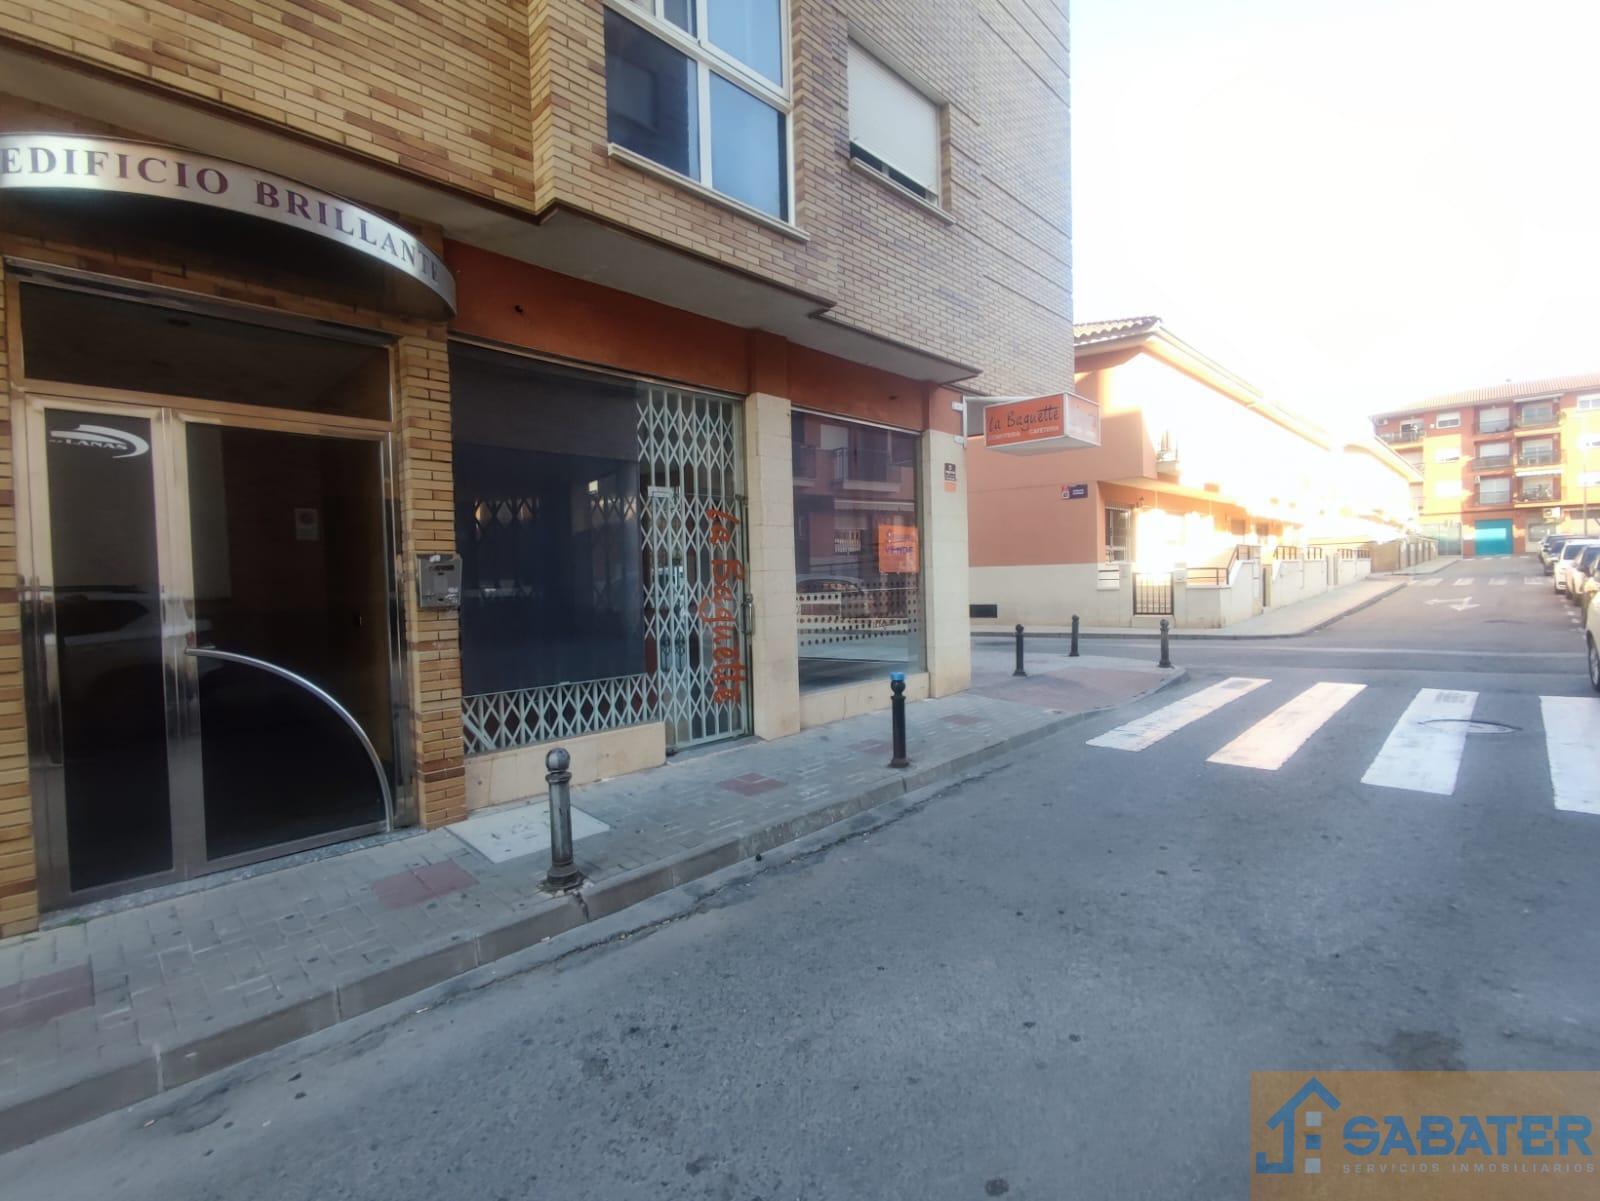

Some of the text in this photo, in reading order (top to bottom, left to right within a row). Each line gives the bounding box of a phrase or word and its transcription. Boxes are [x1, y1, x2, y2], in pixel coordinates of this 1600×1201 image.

[0, 146, 440, 283] EDIFICIO BRILLANTE
[1007, 406, 1059, 431] Baguette
[697, 559, 748, 705] Baguette
